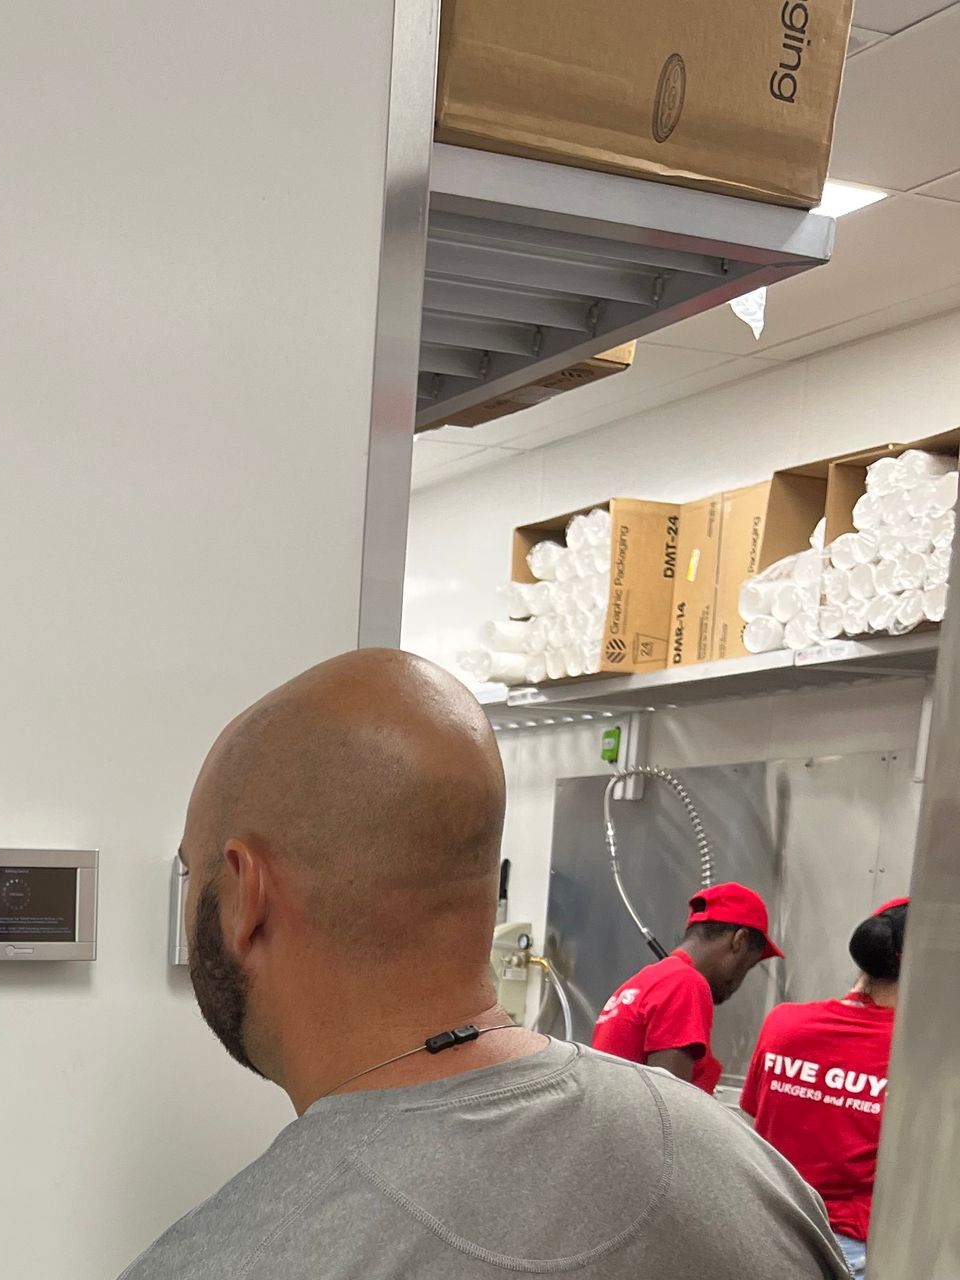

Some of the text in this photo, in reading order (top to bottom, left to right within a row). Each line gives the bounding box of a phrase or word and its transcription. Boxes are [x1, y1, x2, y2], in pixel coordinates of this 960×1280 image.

[770, 0, 811, 103] ging
[664, 515, 680, 579] DMT-24
[610, 525, 630, 635] Graphic Packaging
[765, 1052, 888, 1097] FIVE GUY
[770, 1080, 881, 1115] BURGERS and FRIES
